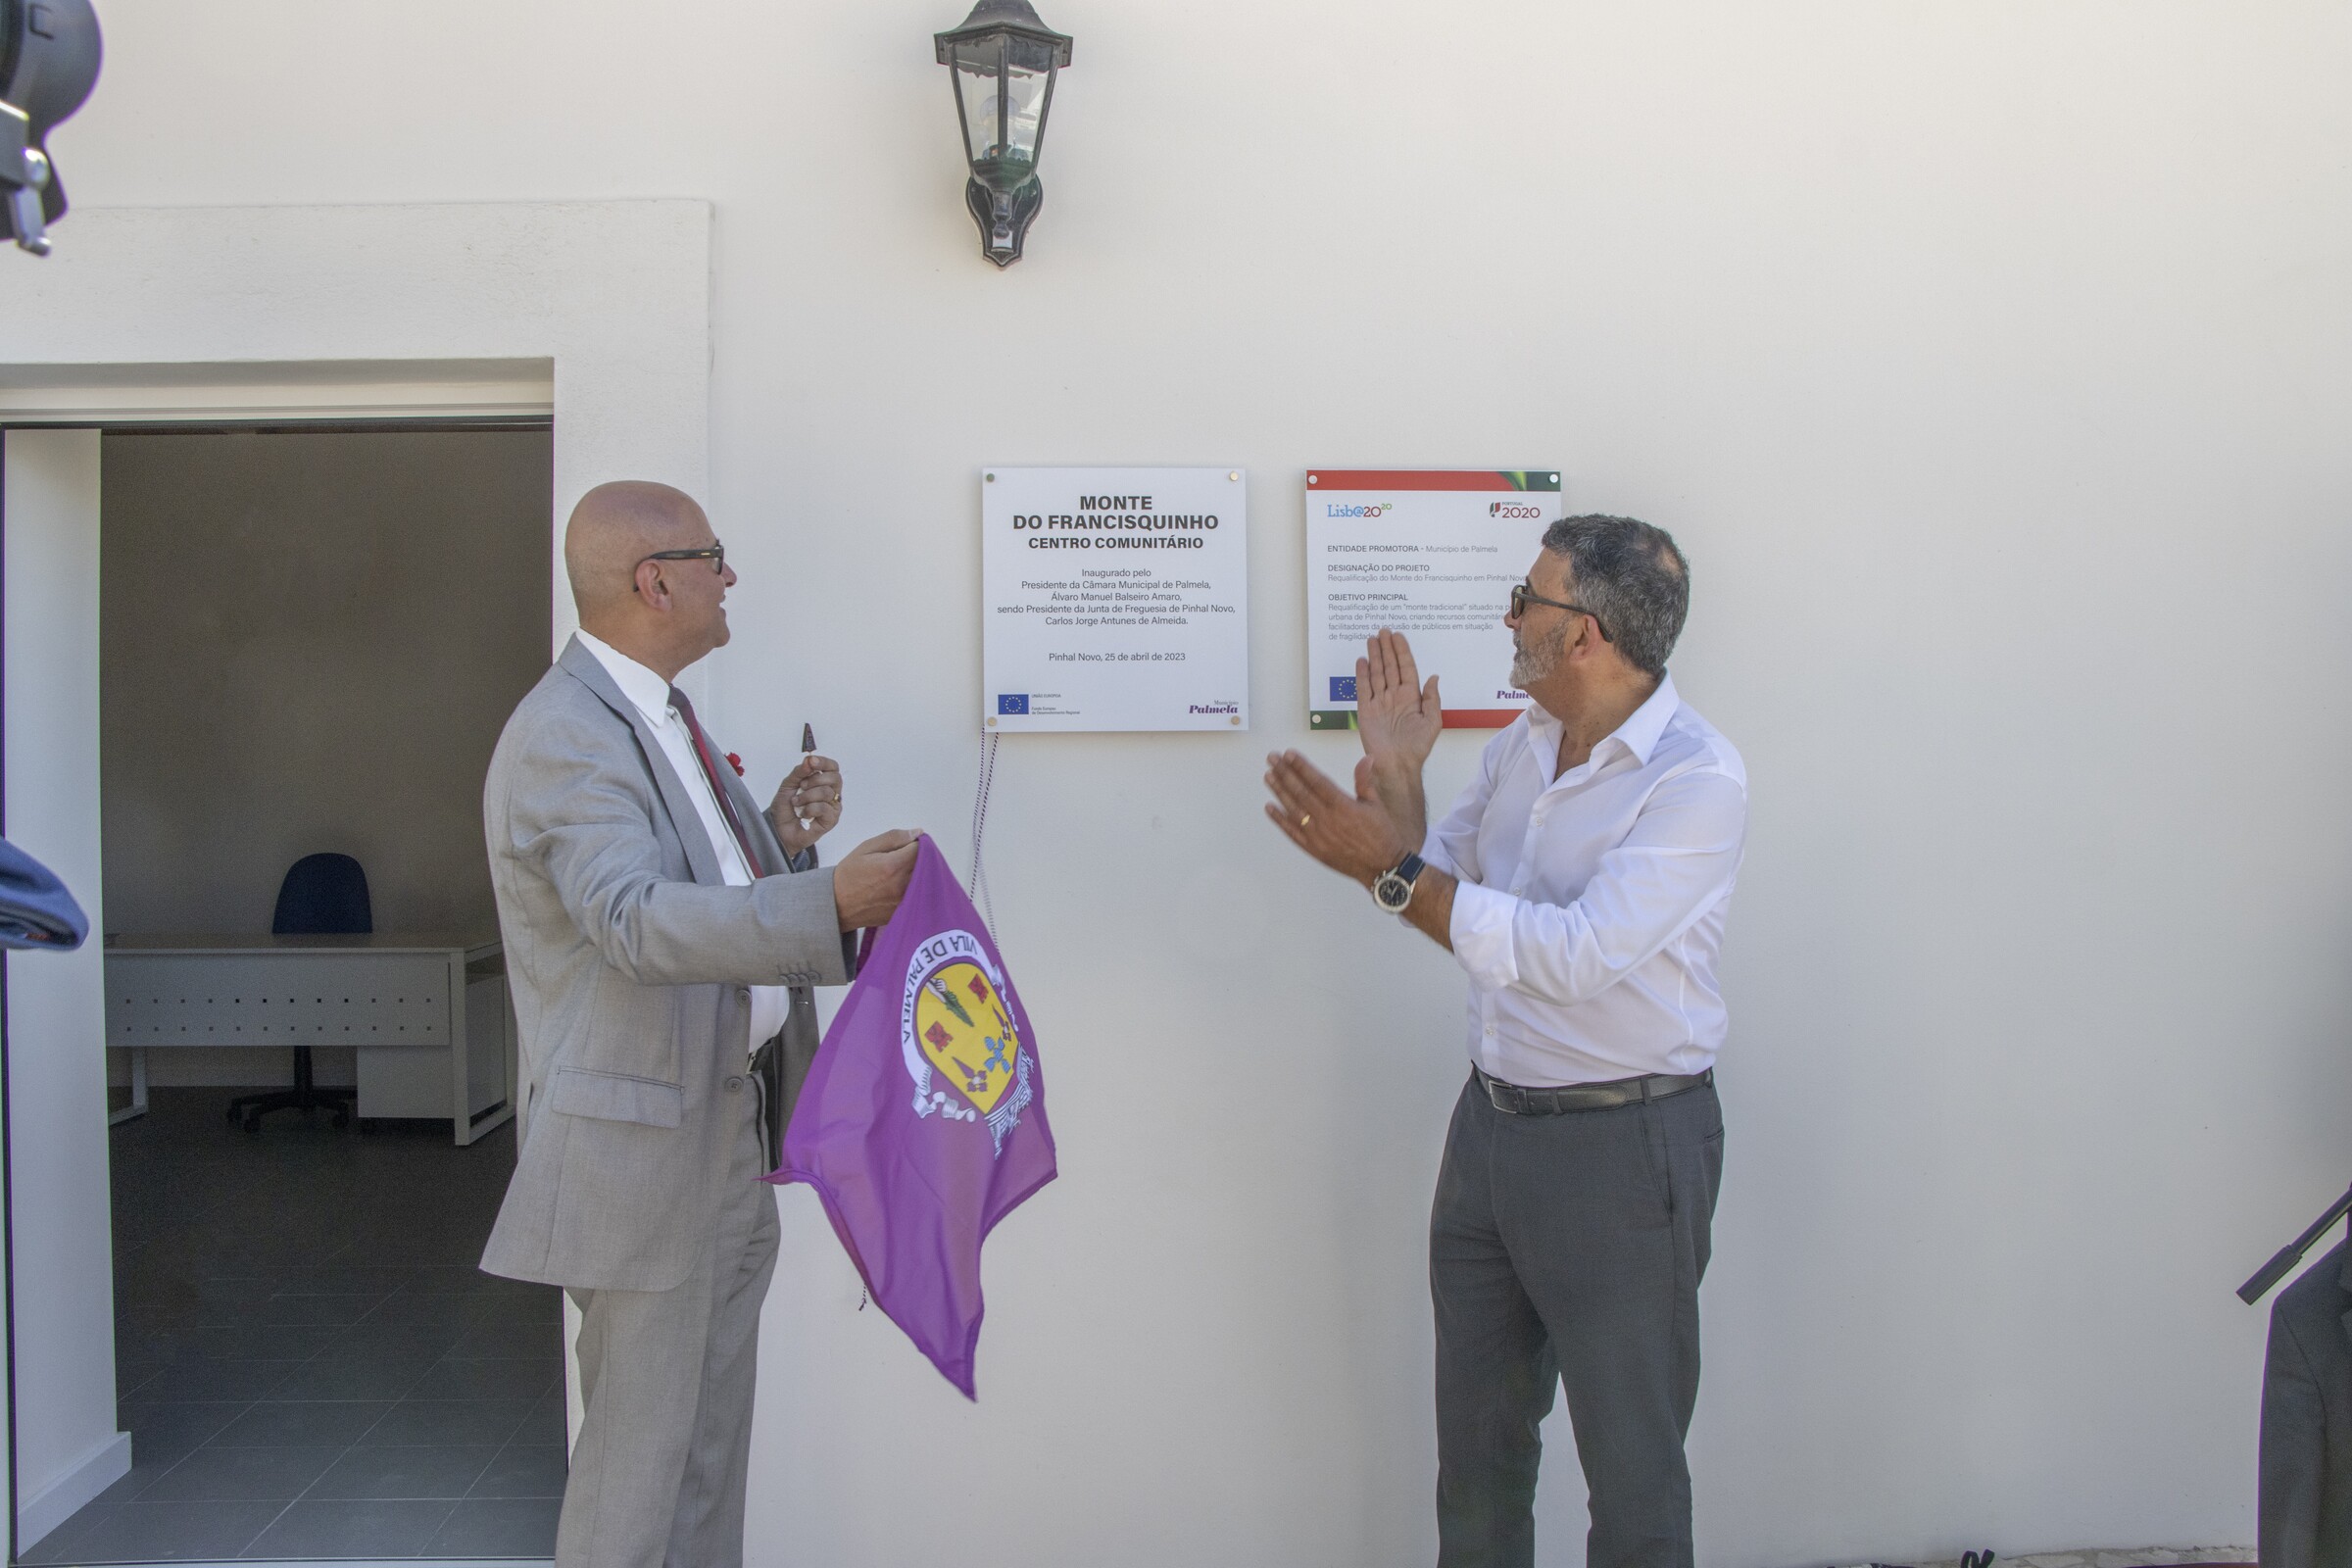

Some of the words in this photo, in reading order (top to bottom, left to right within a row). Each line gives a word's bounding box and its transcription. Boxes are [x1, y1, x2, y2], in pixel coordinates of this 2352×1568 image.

[1079, 496, 1152, 510] MONTE
[1502, 507, 1541, 518] 2020
[1013, 515, 1042, 529] DO
[1048, 515, 1219, 531] FRANCISQUINHO
[1029, 538, 1090, 548] CENTRO
[1095, 535, 1203, 548] COMUNITÁRIO
[1328, 564, 1379, 573] DESIGNAÇÃO
[1082, 569, 1130, 578] Inaugurado
[1133, 569, 1151, 578] pelo
[1328, 574, 1377, 582] Requalificação
[1425, 574, 1472, 582] Francisquinho
[1022, 581, 1067, 589] Presidente
[1069, 581, 1080, 589] da
[1082, 581, 1116, 589] Câmara
[1118, 581, 1160, 589] Municipal
[1176, 581, 1211, 589] Palmela,
[1051, 593, 1078, 601] Álvaro
[1081, 593, 1113, 601] Manuel
[1115, 593, 1149, 601] Balseiro
[1152, 593, 1182, 601] Amaro,
[1026, 605, 1072, 613] Presidente
[1112, 605, 1123, 613] de
[1125, 605, 1166, 614] Freguesia
[1169, 605, 1180, 613] de
[1182, 605, 1208, 613] Pinhal
[1211, 605, 1235, 613] Novo,
[1328, 604, 1377, 612] Requalificação
[1075, 617, 1098, 627] Jorge
[1138, 617, 1149, 625] de
[1152, 617, 1188, 625] Almeida.
[1465, 623, 1493, 631] situação
[1189, 705, 1238, 714] Palmela
[949, 935, 977, 955] VILA
[921, 939, 948, 964] DE
[903, 958, 925, 1043] PALMELA
